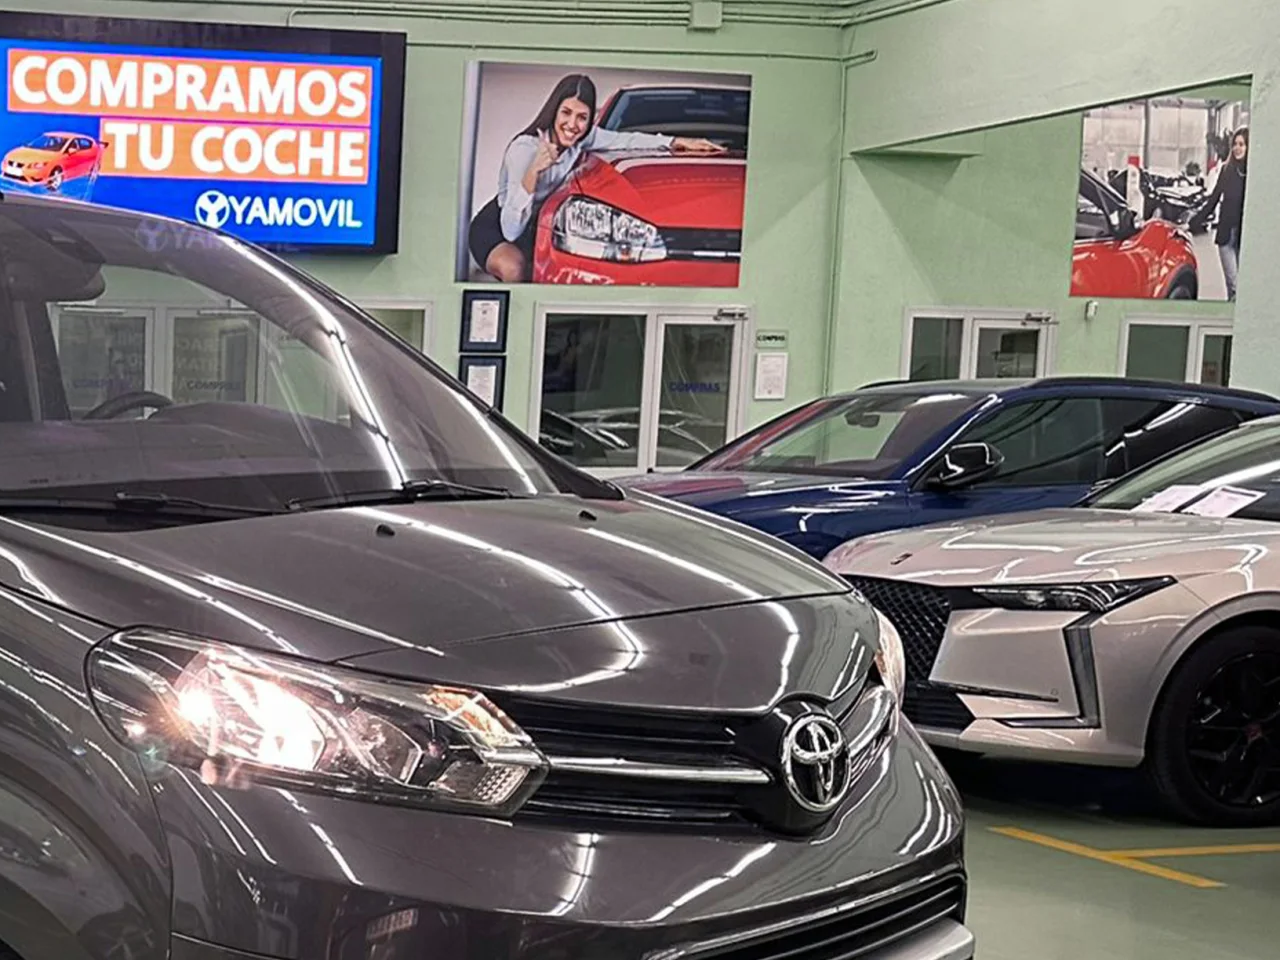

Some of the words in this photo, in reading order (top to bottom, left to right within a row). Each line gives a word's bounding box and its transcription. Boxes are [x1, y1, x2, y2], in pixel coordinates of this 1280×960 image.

[11, 56, 367, 118] COMPRAMOS
[104, 123, 174, 170] TU
[190, 126, 365, 177] COCHE
[229, 194, 363, 228] YAMOVIL
